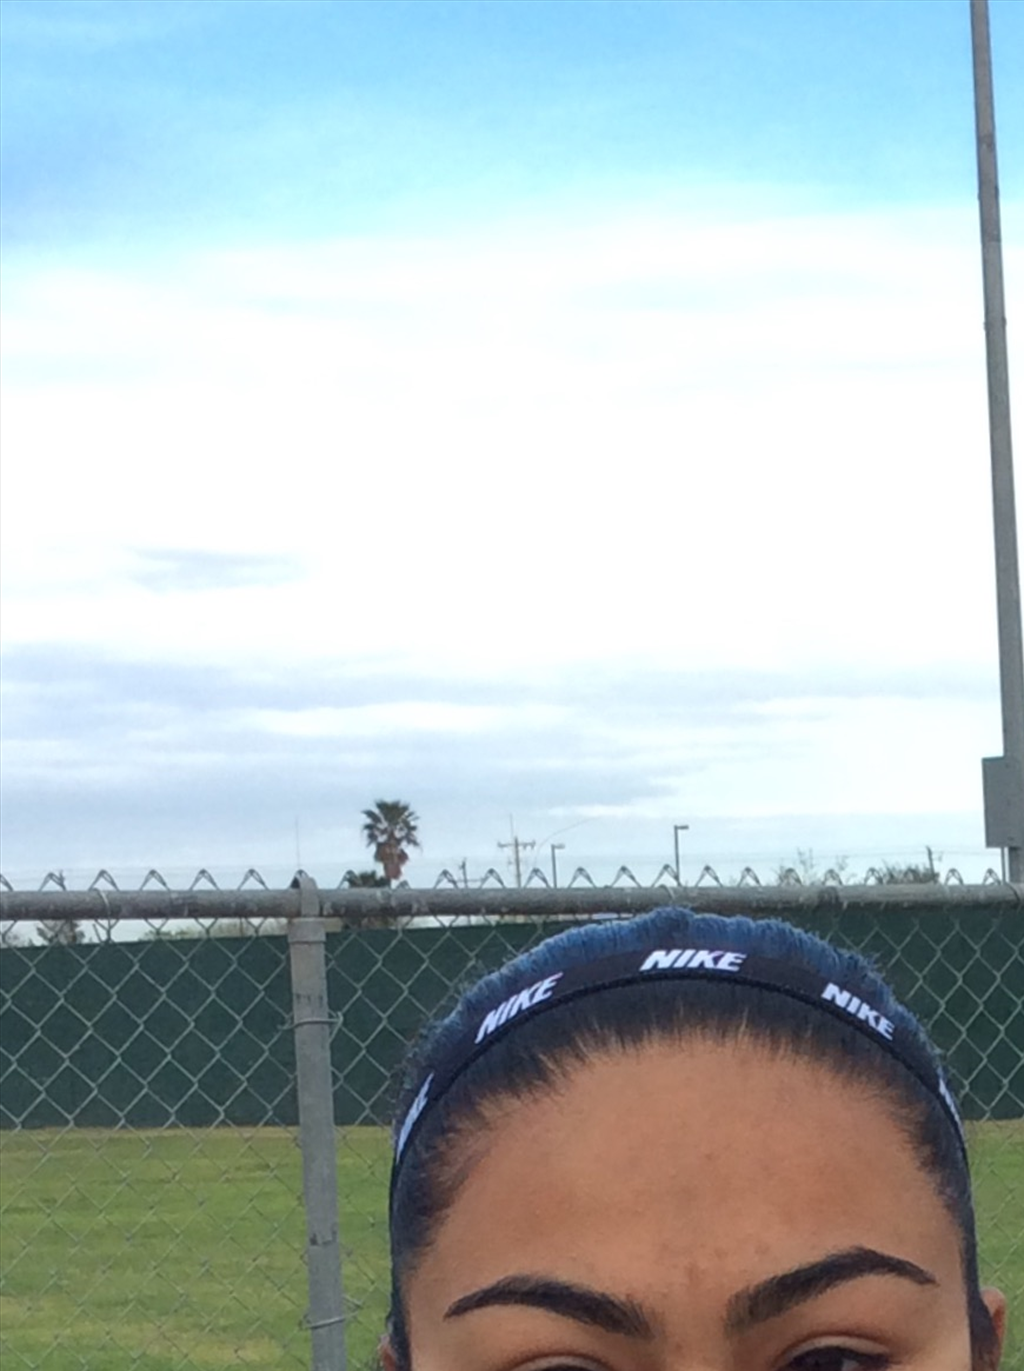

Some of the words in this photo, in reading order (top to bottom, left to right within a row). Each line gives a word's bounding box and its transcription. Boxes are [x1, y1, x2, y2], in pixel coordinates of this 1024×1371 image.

[639, 949, 747, 972] NIKE
[474, 972, 563, 1045] NIKE
[821, 982, 896, 1041] NIKE
